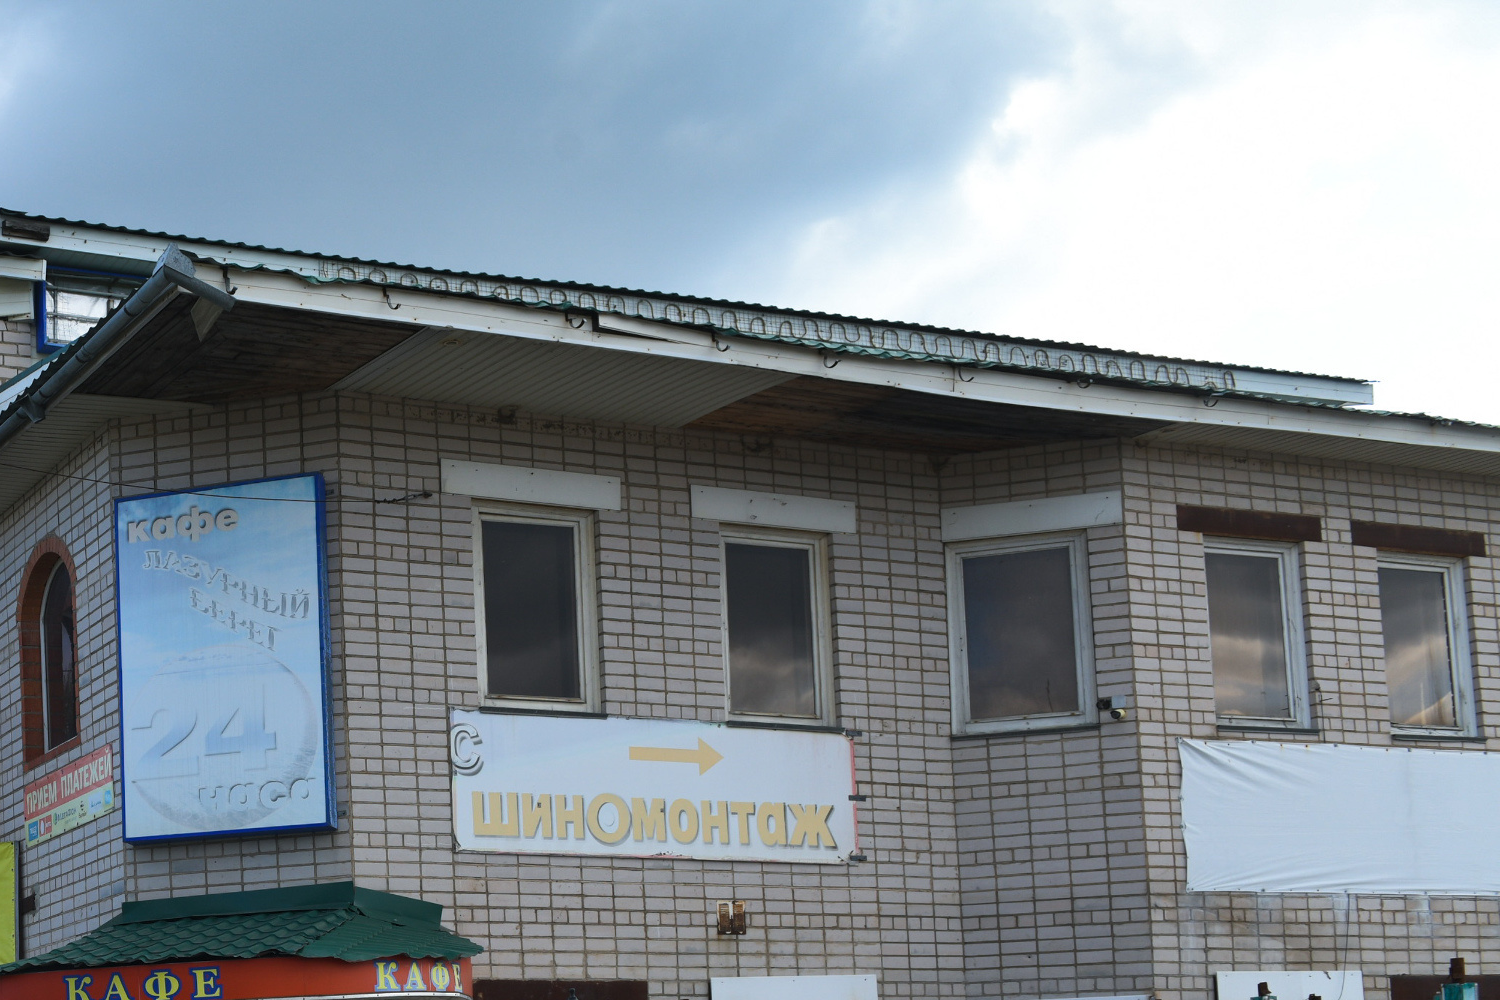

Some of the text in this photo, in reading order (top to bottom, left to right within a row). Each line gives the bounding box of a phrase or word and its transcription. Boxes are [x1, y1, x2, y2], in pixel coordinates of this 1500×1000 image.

[127, 506, 239, 543] кафе
[143, 550, 310, 619] ЛАЗУРНЫЙ
[131, 684, 277, 783] 24
[26, 747, 112, 815] ПРИЕМ ПЛАТЕЖЕЙ
[199, 777, 316, 811] часа
[375, 960, 463, 993] КАФЕ
